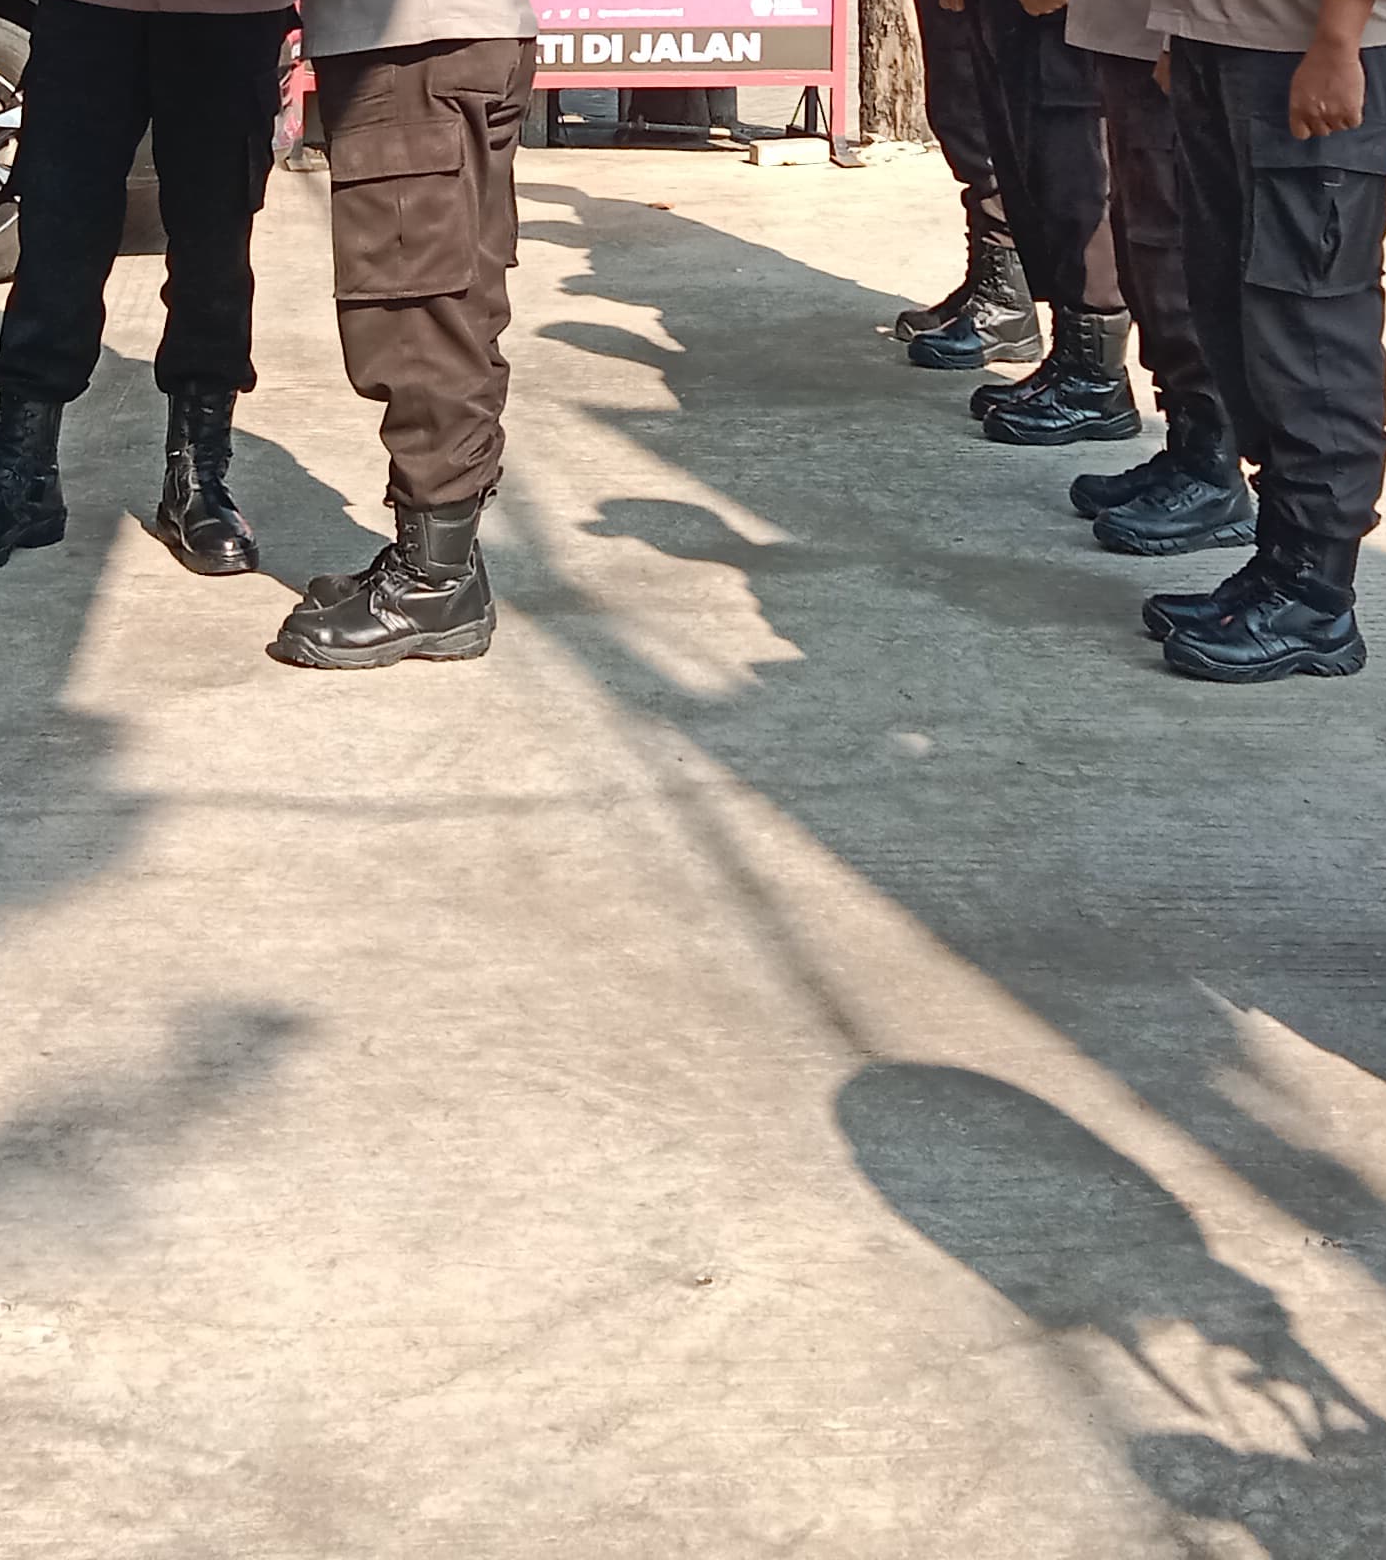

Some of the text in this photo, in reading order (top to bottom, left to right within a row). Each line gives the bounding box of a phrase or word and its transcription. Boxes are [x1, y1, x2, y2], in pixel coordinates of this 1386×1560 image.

[535, 31, 762, 64] TI DI JALAN
